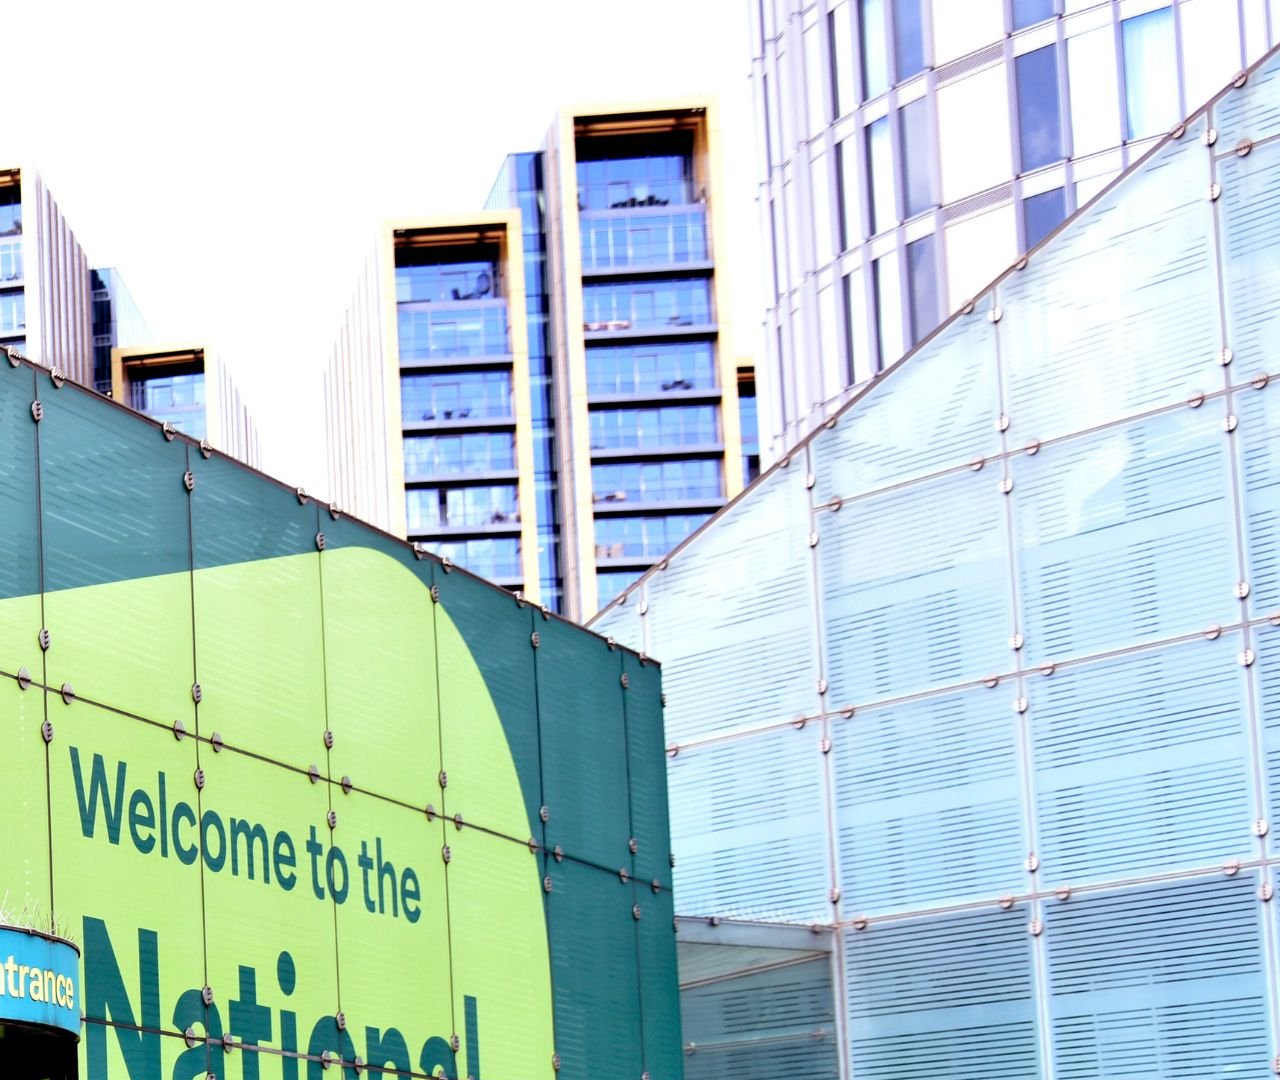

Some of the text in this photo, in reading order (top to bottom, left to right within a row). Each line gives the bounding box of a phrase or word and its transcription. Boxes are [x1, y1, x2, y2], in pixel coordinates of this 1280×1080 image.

[69, 745, 421, 923] Welcome to the
